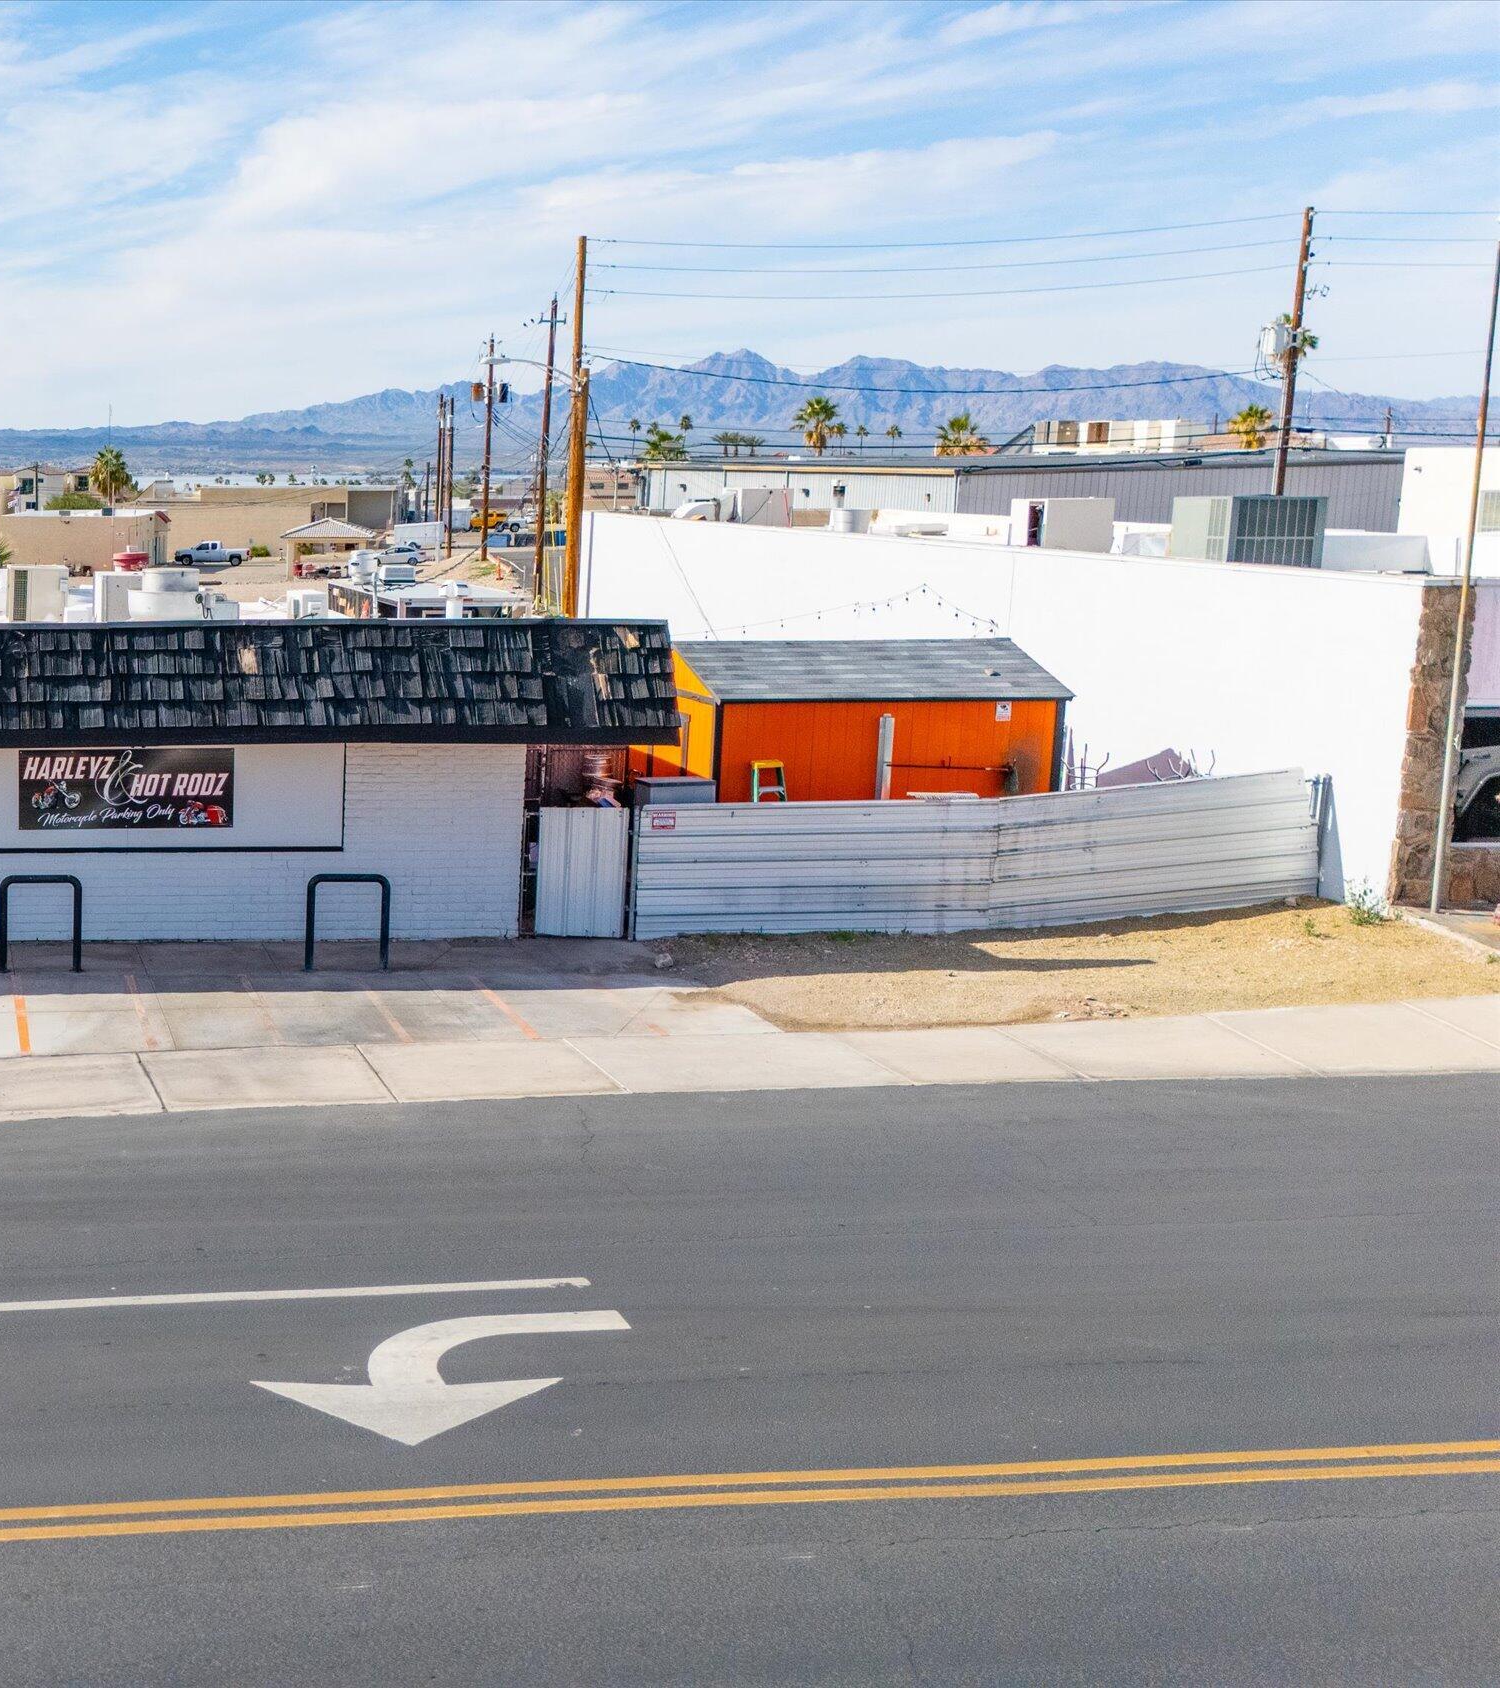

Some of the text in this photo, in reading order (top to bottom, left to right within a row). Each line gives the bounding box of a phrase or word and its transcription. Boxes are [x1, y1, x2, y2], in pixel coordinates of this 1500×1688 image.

[22, 756, 116, 780] HARLEYZ
[130, 773, 230, 797] HOT RODZ
[37, 803, 175, 828] Motorcycle Parking Only
